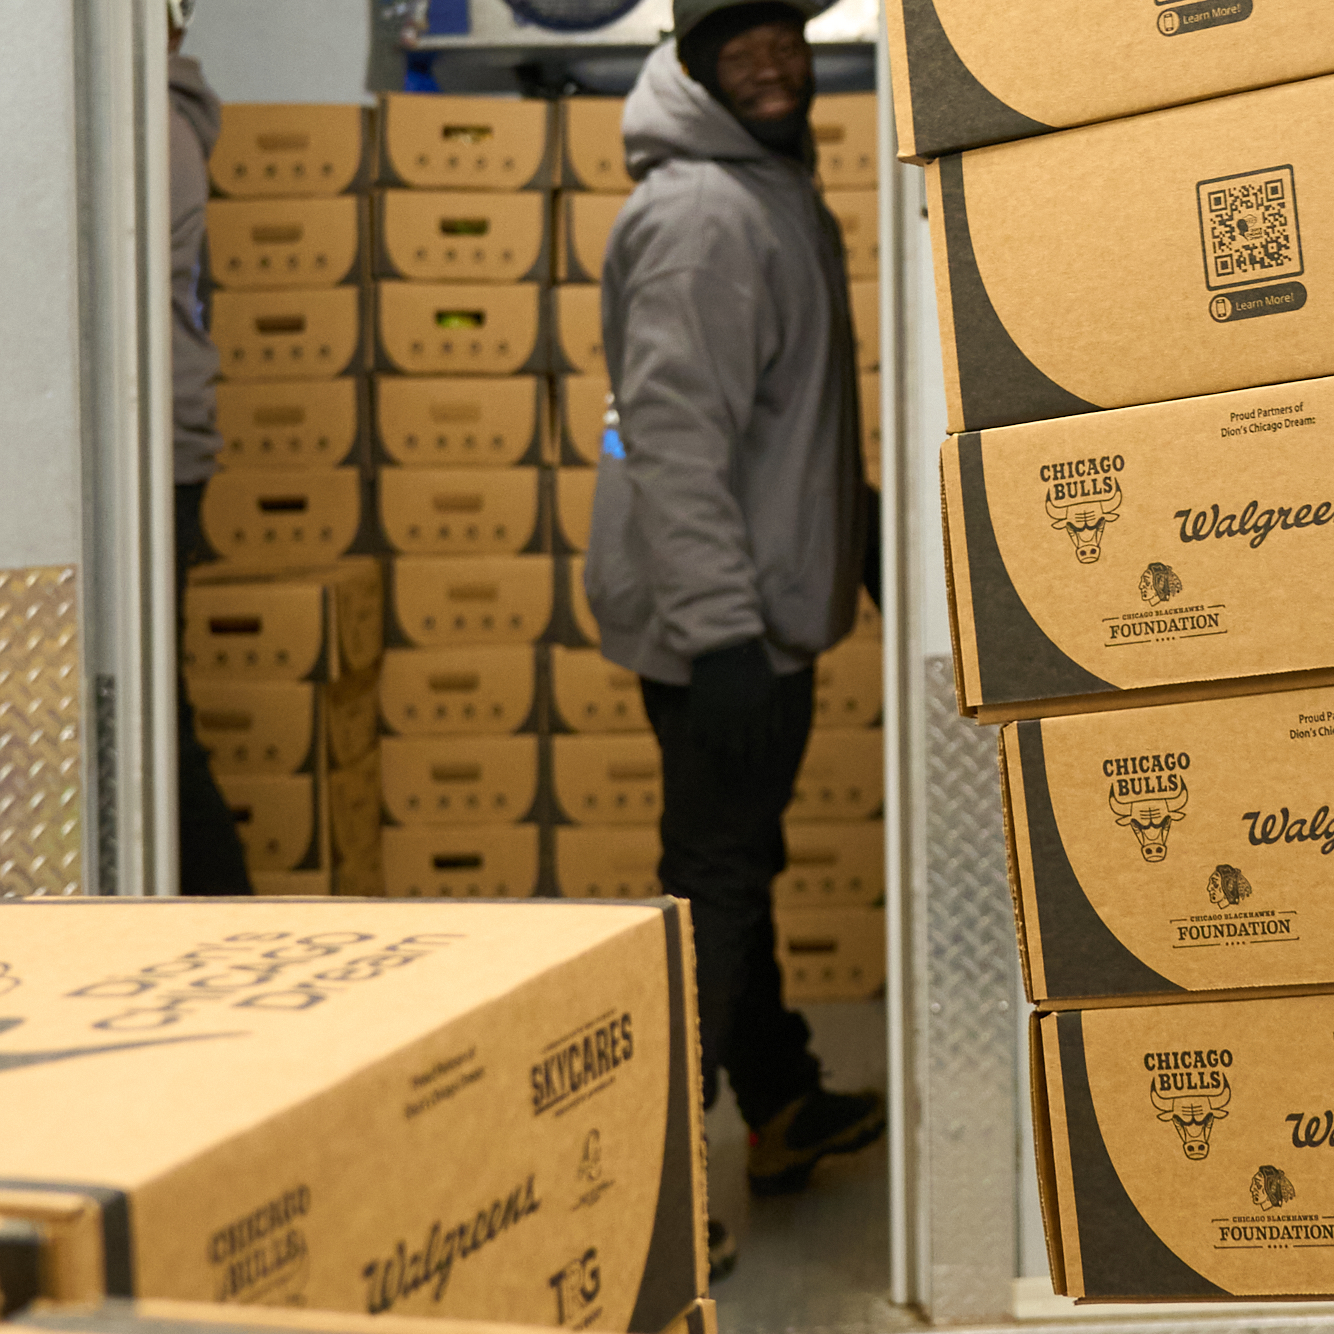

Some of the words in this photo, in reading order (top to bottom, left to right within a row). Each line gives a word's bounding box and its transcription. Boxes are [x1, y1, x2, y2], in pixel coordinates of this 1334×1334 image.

[1182, 11, 1210, 25] Learn
[1212, 4, 1242, 18] More!
[1236, 299, 1263, 311] Learn
[1265, 292, 1294, 305] More!
[1230, 409, 1256, 421] Proud
[1257, 406, 1292, 417] Partners
[1294, 401, 1304, 412] of
[1220, 425, 1248, 437] Dion's
[1249, 422, 1282, 433] Chicago
[1284, 417, 1316, 427] Dream:
[1040, 455, 1125, 482] CHICAGO
[1054, 476, 1113, 501] BULLS
[1122, 611, 1153, 620] CHICAGO
[1155, 605, 1205, 616] BLACKHAWKS
[1110, 613, 1220, 639] FOUNDATION
[1299, 712, 1325, 724] Proud
[1290, 728, 1317, 739] Dion's
[1103, 752, 1190, 777] CHICAGO
[1117, 774, 1178, 797] BULLS
[1190, 914, 1222, 922] CHICAGO
[1224, 910, 1275, 919] BLACKHAWKS
[1178, 919, 1291, 941] FOUNDATION
[531, 1012, 634, 1107] SKYCARES
[1144, 1049, 1233, 1071] CHICAGO
[1158, 1071, 1221, 1091] BULLS
[1220, 1225, 1334, 1241] FOUNDATION
[362, 1173, 542, 1316] Walgreens
